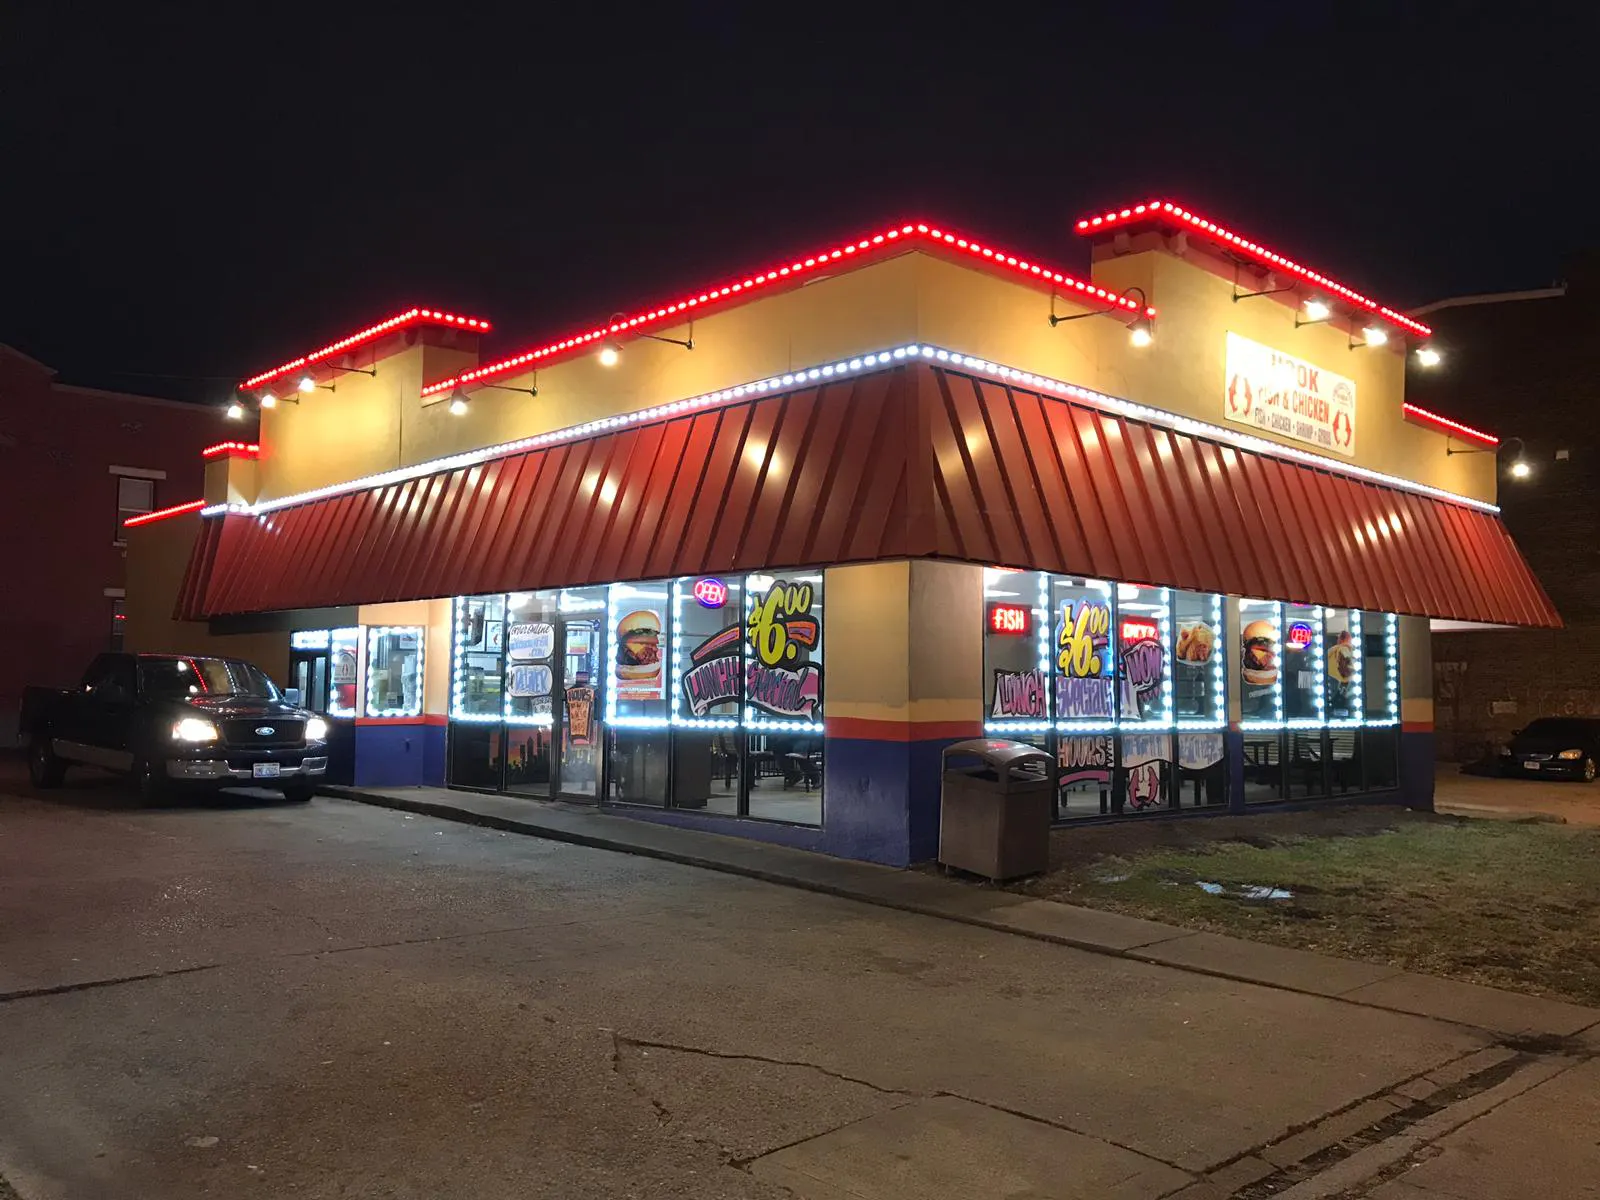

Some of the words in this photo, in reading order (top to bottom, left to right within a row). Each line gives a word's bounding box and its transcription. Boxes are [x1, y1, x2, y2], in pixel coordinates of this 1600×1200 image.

[1271, 353, 1319, 393] OK
[1282, 390, 1290, 411] &
[1292, 389, 1330, 424] CHICKEN
[694, 581, 726, 604] OPEN
[993, 608, 1025, 631] FISH
[1291, 627, 1312, 645] OPEN
[687, 656, 740, 707] LUNCH
[1127, 646, 1162, 686] WOW
[998, 668, 1047, 719] LUNCH
[1057, 735, 1106, 767] HOURS
